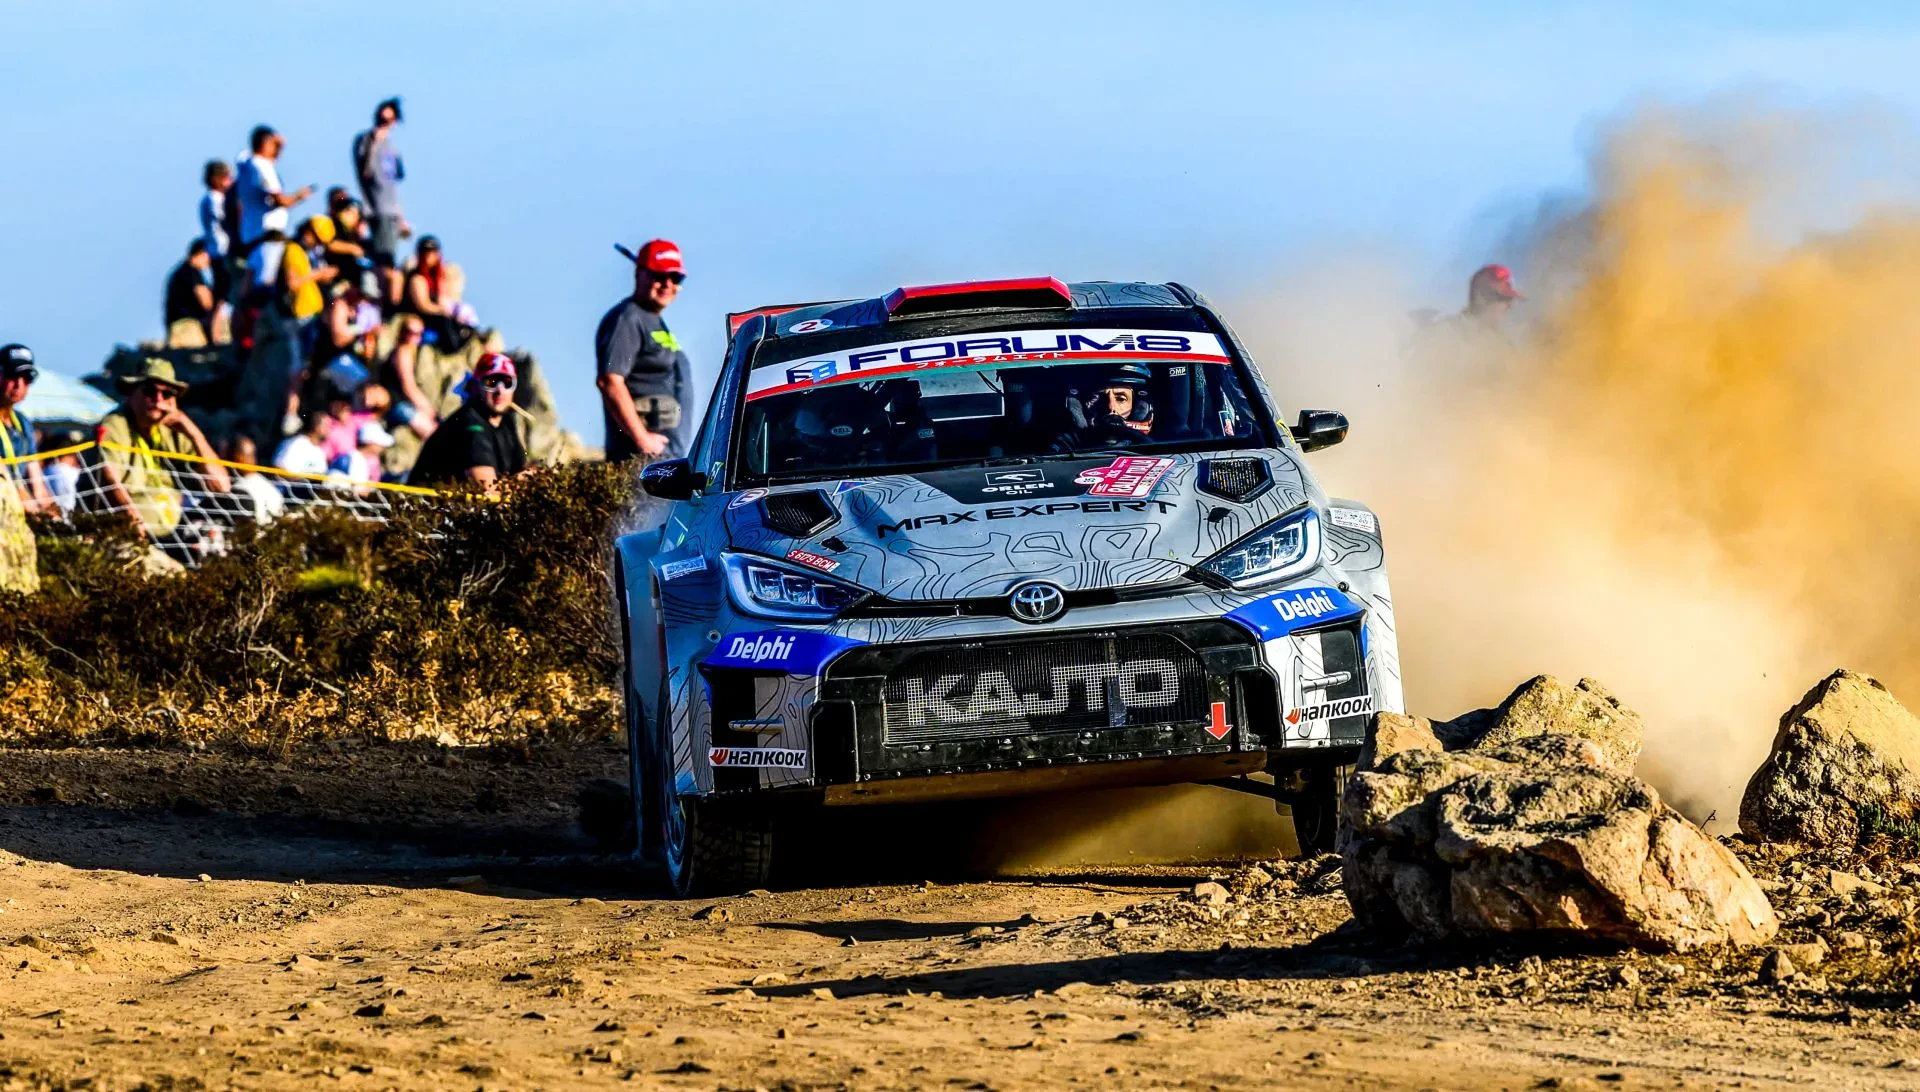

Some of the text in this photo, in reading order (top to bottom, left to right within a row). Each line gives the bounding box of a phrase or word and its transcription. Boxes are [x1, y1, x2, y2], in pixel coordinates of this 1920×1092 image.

[848, 334, 1192, 371] FORUM8
[1169, 367, 1186, 376] OMP
[981, 482, 1055, 493] ORLEN
[1107, 475, 1142, 493] RALLY
[1125, 459, 1158, 475] ITALIA
[877, 500, 1178, 539] MAX EXPERT
[787, 550, 798, 558] S
[794, 552, 816, 563] 6179
[1272, 590, 1338, 621] Delphi
[724, 636, 796, 663] Delphi
[907, 658, 1180, 726] KAJTO
